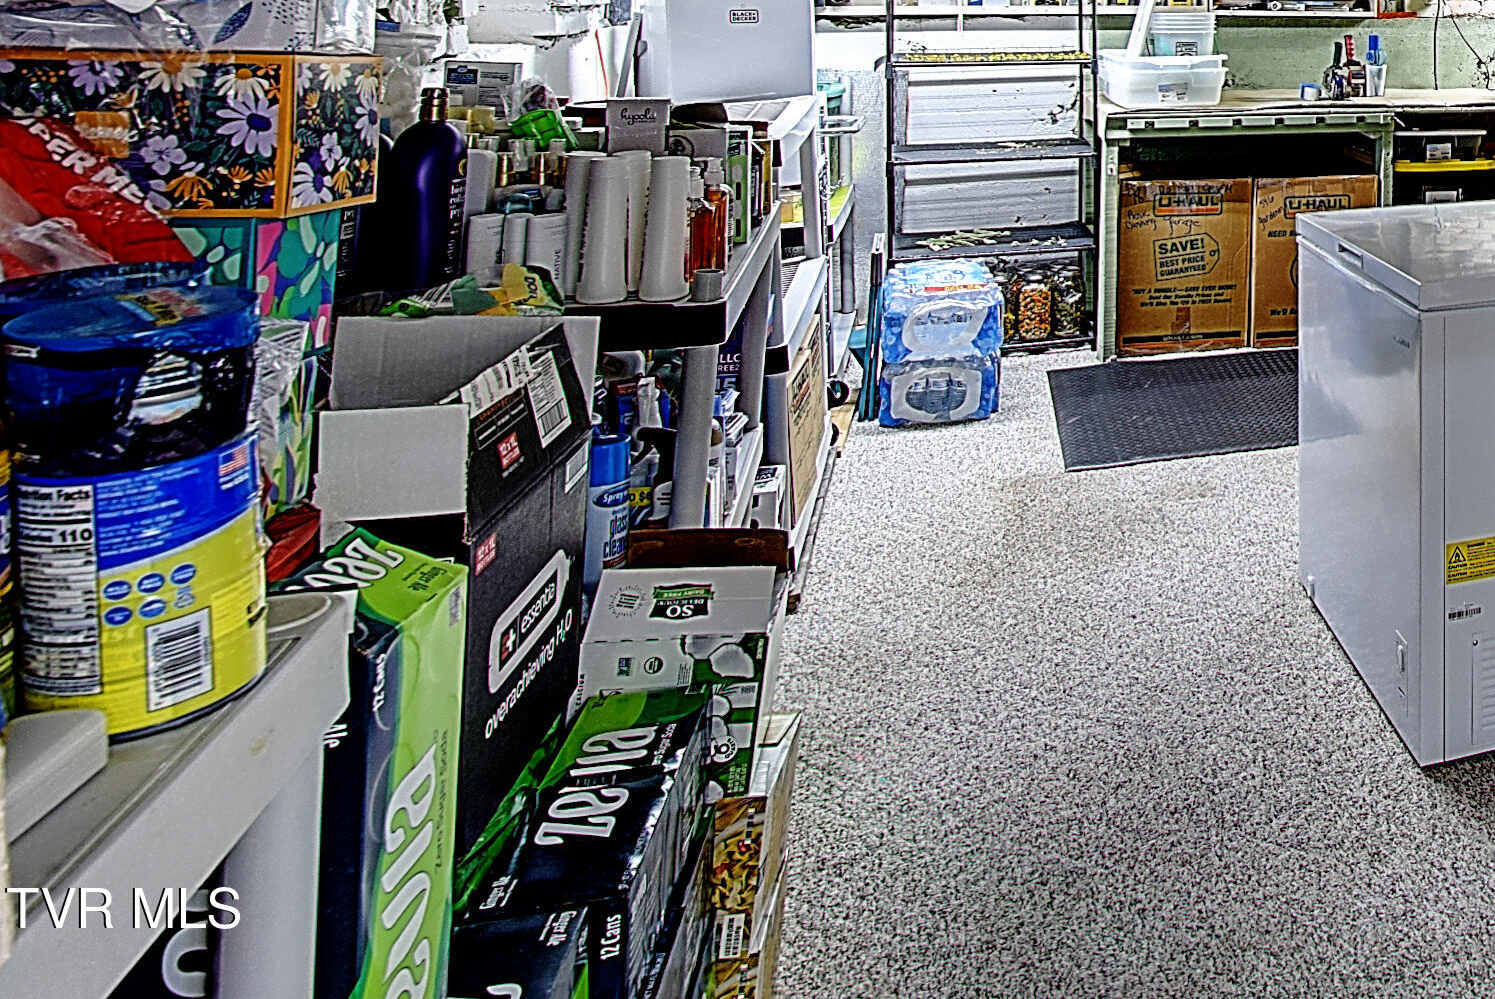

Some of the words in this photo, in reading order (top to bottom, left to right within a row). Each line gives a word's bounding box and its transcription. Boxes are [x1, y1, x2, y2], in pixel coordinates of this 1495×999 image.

[1158, 195, 1219, 208] U-HAUL
[1289, 198, 1346, 210] U-HAUL
[1158, 238, 1205, 255] SAVE!
[1160, 259, 1180, 269] BEST
[1182, 255, 1205, 265] PRICE
[59, 528, 93, 542] 110
[521, 582, 556, 633] essentia
[666, 604, 694, 618] SO
[485, 636, 555, 740] overachieving
[381, 744, 437, 999] evia
[601, 914, 621, 945] Cans
[600, 944, 620, 960] 12
